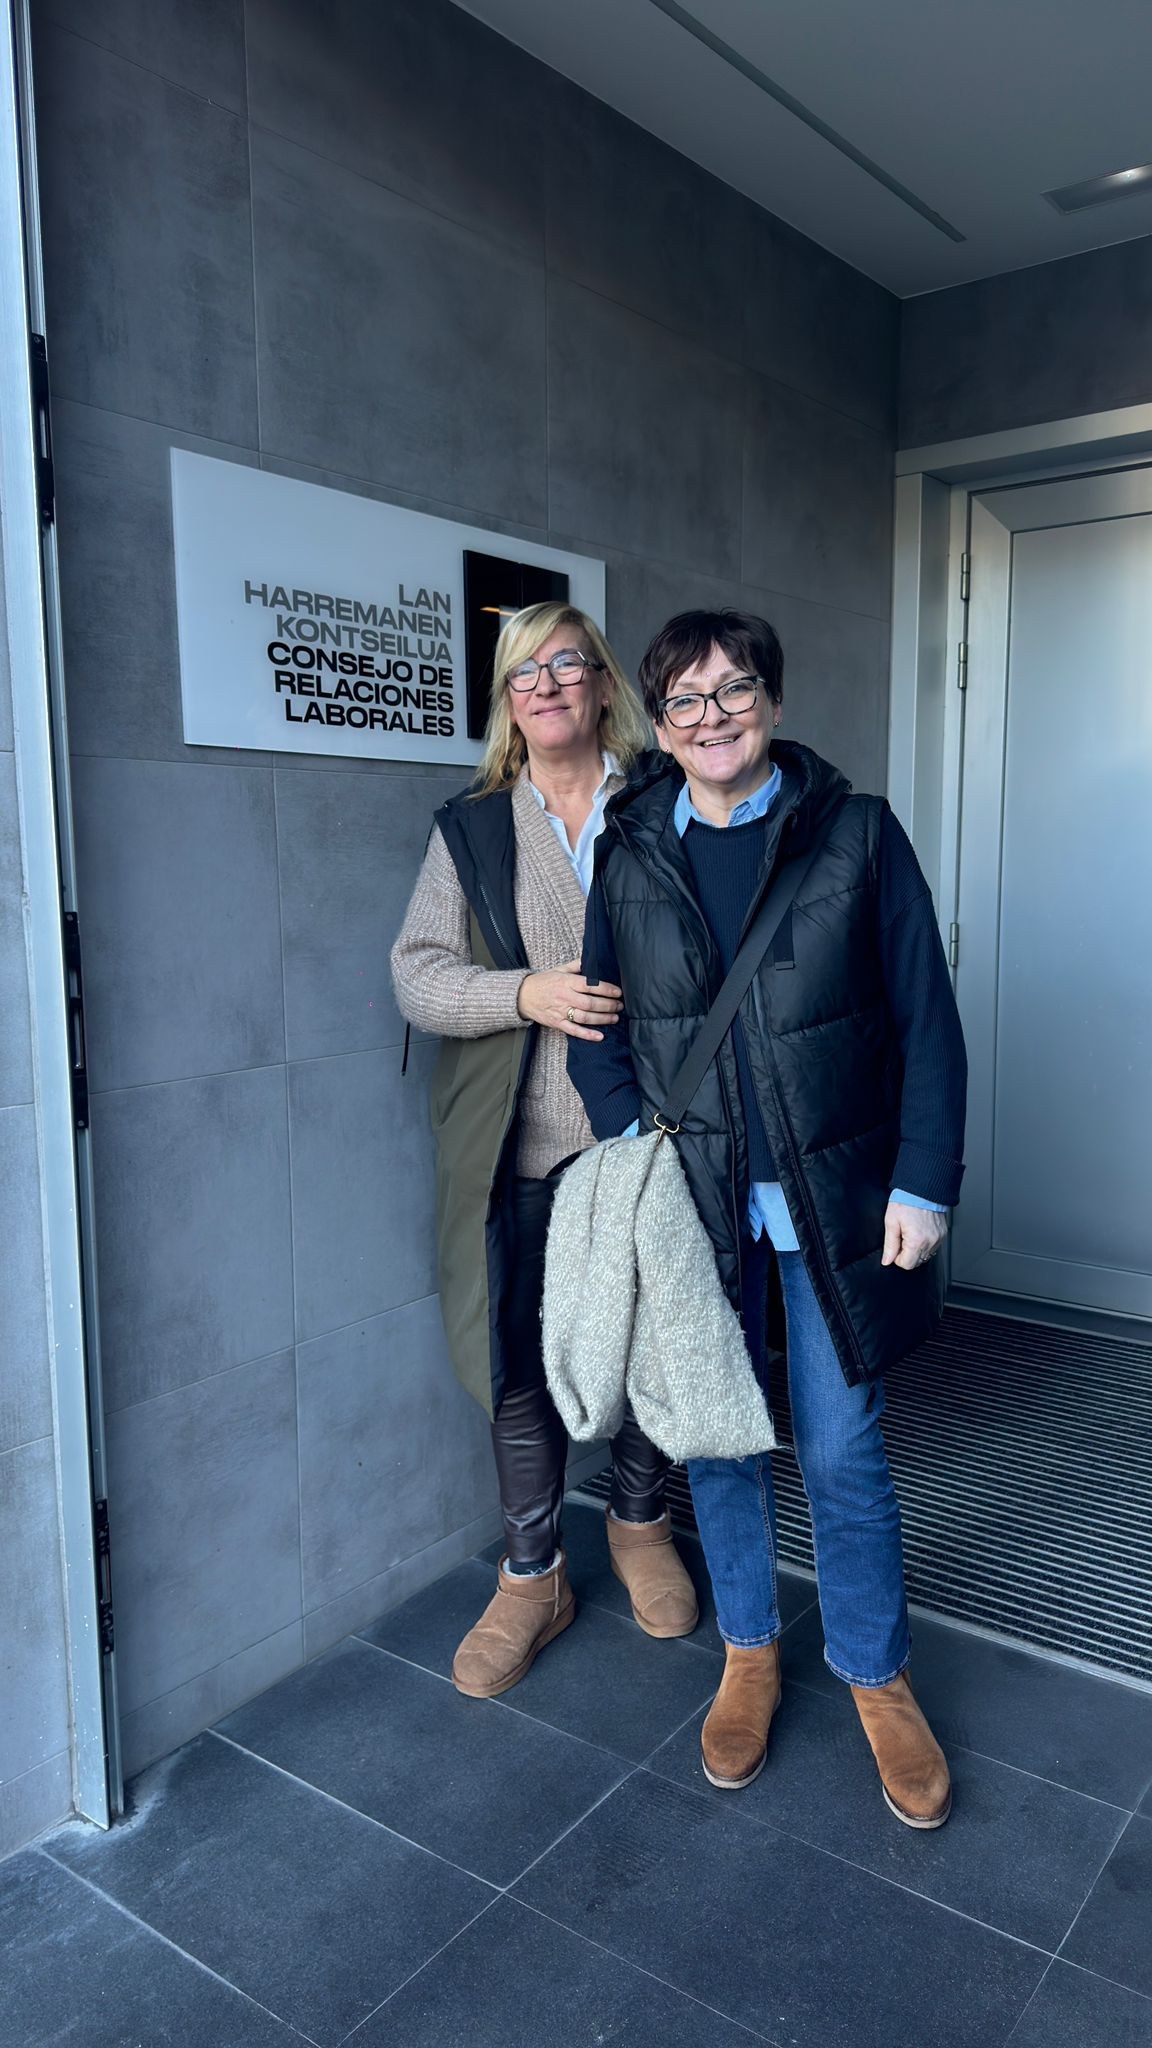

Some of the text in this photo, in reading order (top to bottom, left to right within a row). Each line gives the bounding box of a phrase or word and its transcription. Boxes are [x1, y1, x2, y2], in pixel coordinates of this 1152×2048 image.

[244, 579, 452, 640] HARREMANEN
[398, 583, 452, 614] LAN
[276, 614, 453, 664] KONTSEILUA
[267, 641, 453, 689] CONSEJO DE
[274, 669, 454, 713] RELACIONES
[284, 698, 455, 737] LABORALES
